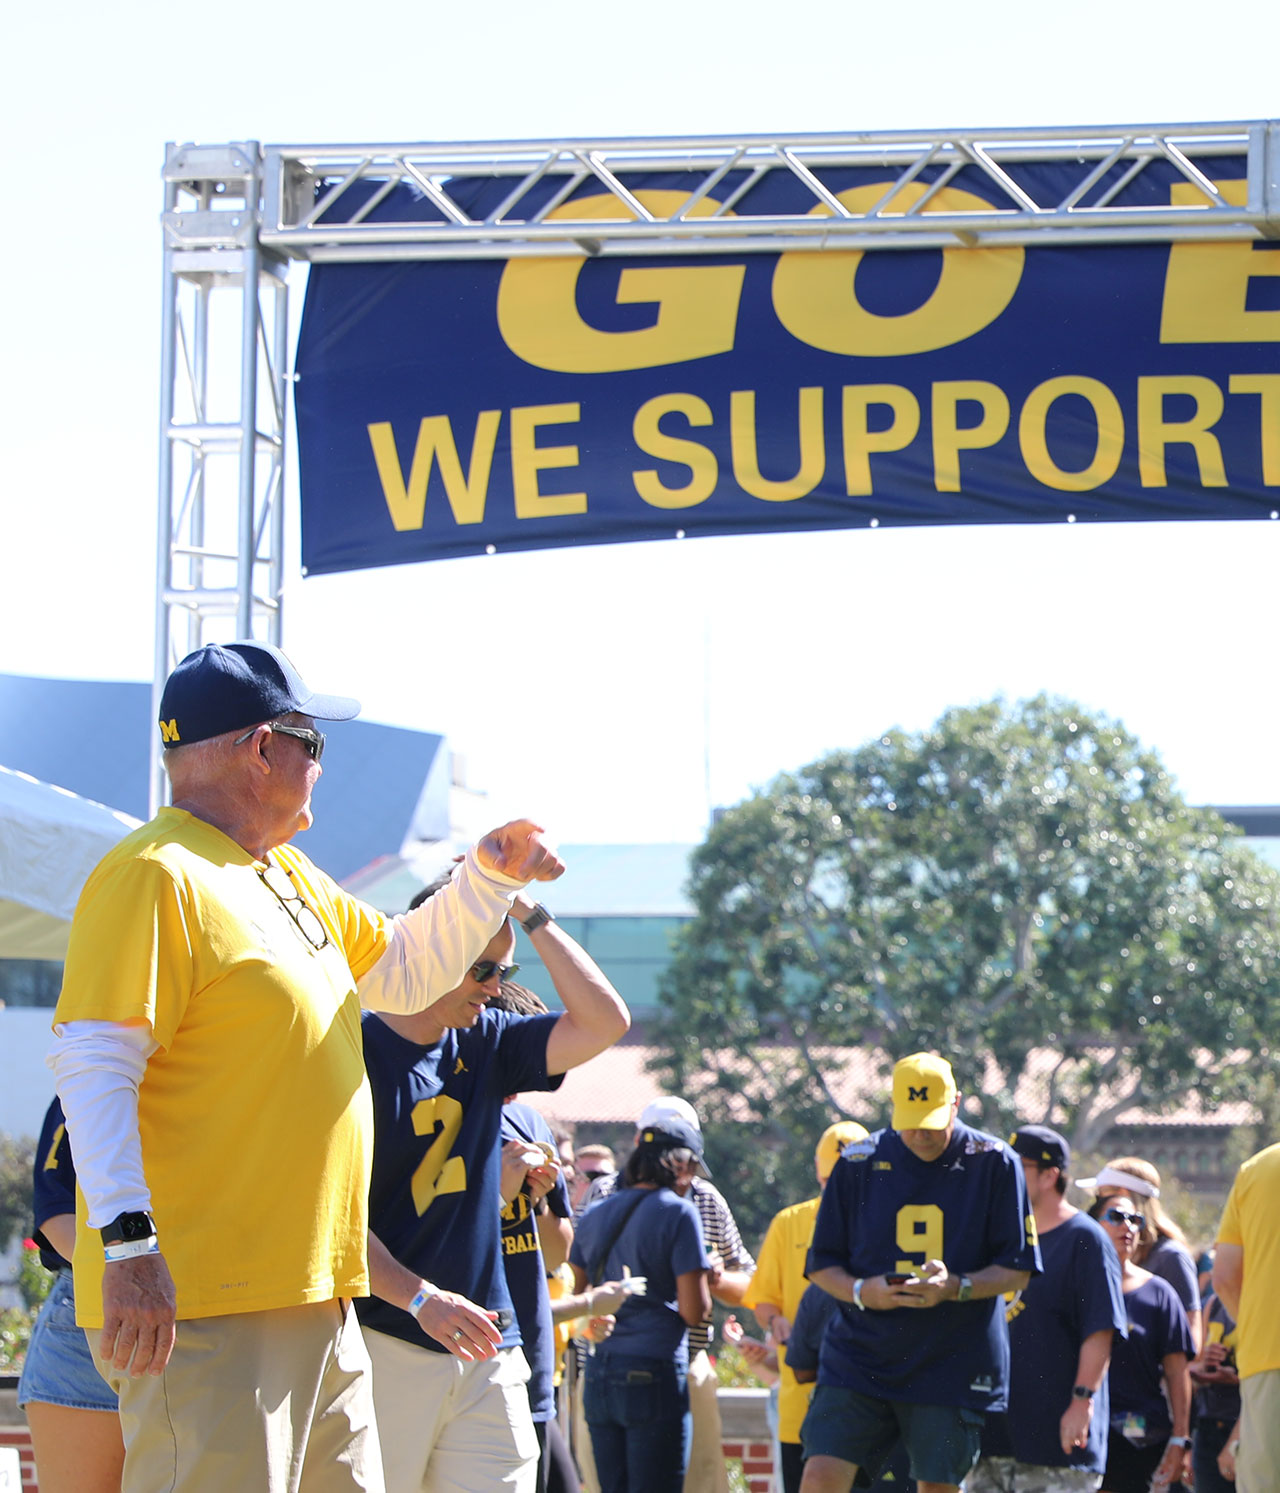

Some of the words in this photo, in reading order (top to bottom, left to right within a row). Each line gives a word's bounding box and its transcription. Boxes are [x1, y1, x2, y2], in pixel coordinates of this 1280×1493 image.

[498, 183, 1025, 372] GO
[368, 403, 588, 531] WE
[159, 718, 181, 743] M
[907, 1086, 929, 1102] M
[410, 1093, 468, 1219] 2
[895, 1203, 945, 1279] 9
